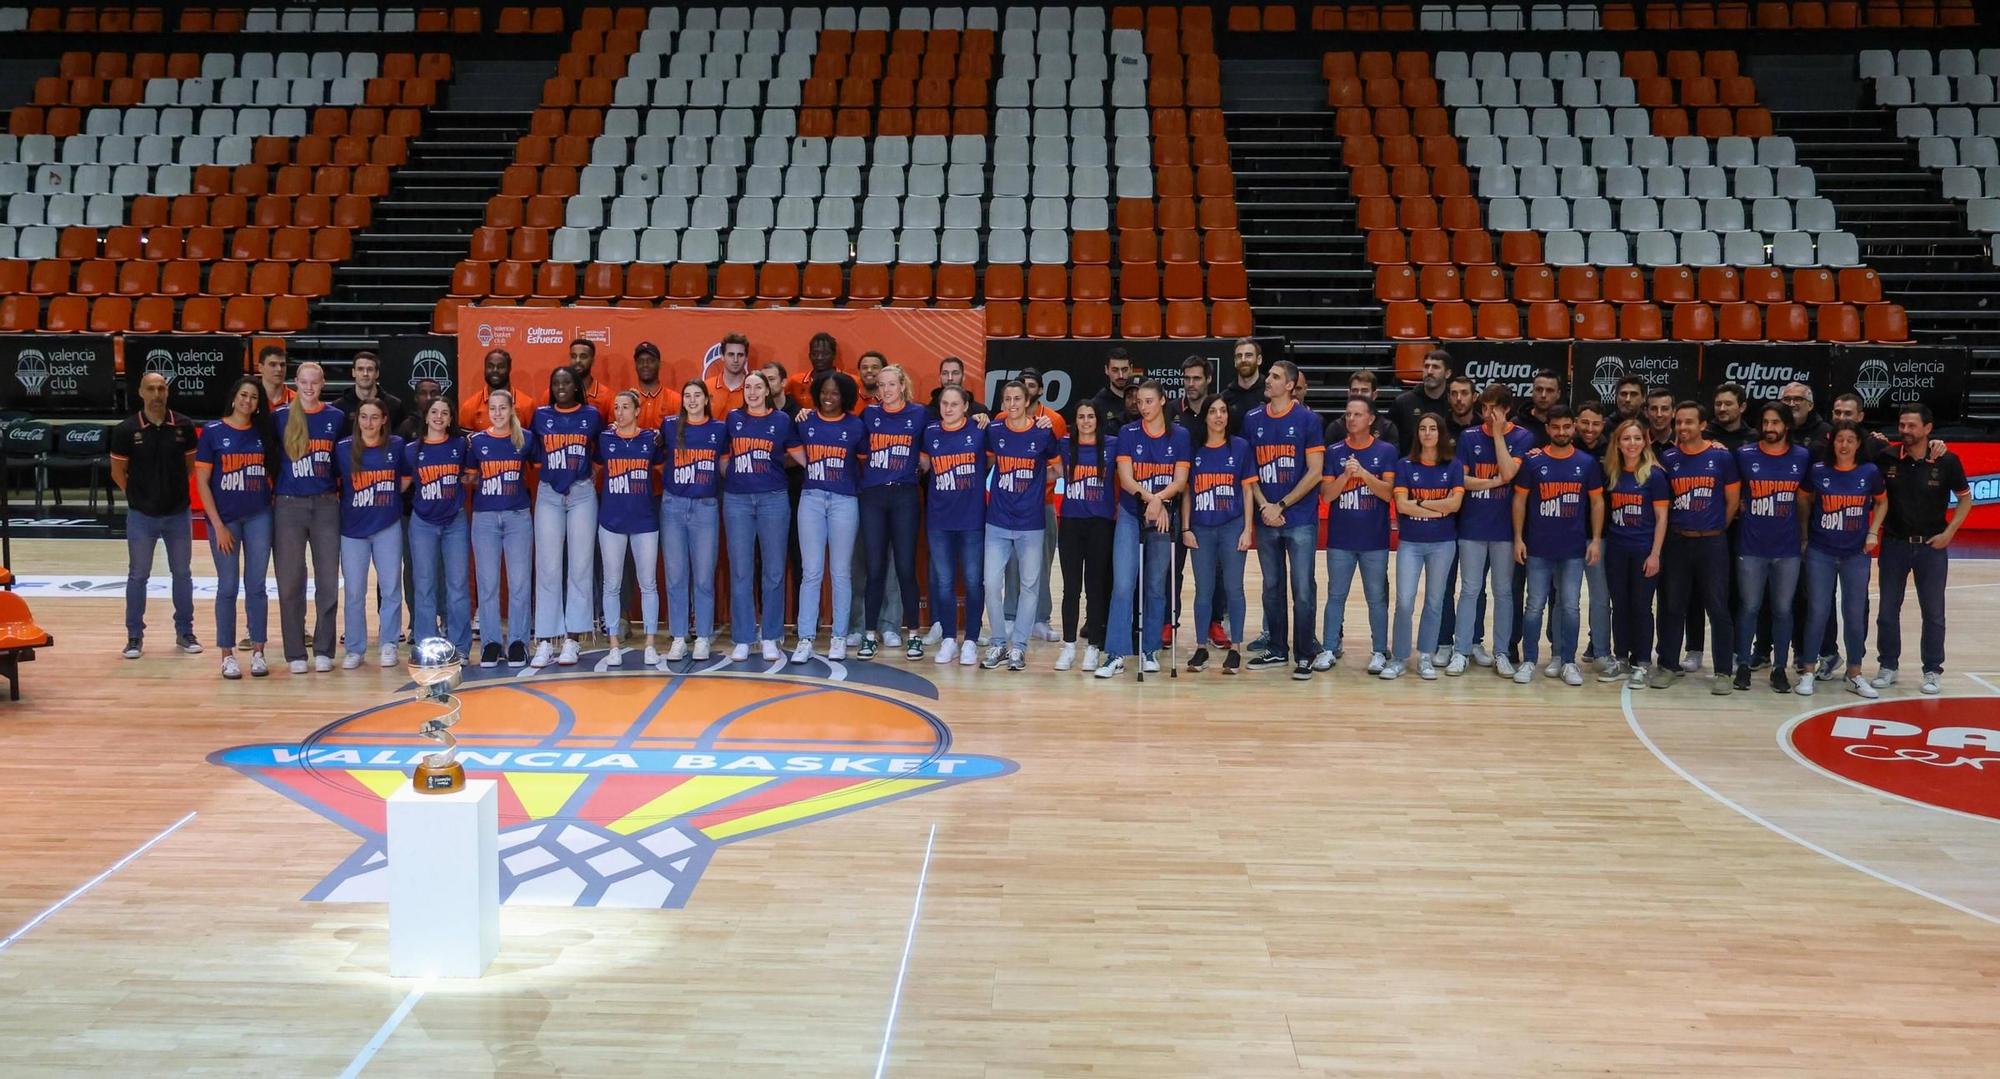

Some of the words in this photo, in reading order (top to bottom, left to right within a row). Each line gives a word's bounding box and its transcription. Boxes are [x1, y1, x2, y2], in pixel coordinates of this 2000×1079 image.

[527, 327, 555, 336] Cultura
[527, 335, 564, 344] Esfuerzo
[48, 348, 96, 361] valencia
[176, 348, 223, 362] valencia
[1629, 356, 1679, 370] valencia
[49, 362, 89, 376] basket
[177, 363, 216, 376] basket
[1465, 360, 1531, 379] Cultura
[1725, 362, 1793, 381] Cultura
[1794, 371, 1809, 381] del
[1893, 360, 1944, 373] valencia
[50, 376, 77, 389] club
[177, 377, 204, 390] club
[1893, 374, 1935, 388] basket
[1891, 388, 1920, 402] club
[543, 434, 588, 453] CAMPIONES
[568, 445, 586, 457] REINA
[732, 437, 774, 456] CAMPIONES
[870, 433, 913, 451] CAMPIONES
[891, 445, 910, 457] REINA
[674, 448, 715, 468] CAMPIONES
[806, 444, 847, 463] CAMPIONES
[870, 449, 889, 469] COPA
[1256, 444, 1296, 466] CAMPIONES
[1278, 457, 1295, 468] REINA
[246, 465, 266, 477] REINA
[292, 456, 315, 478] COPA
[480, 460, 521, 479] CAMPIONES
[607, 459, 649, 477] CAMPIONES
[697, 460, 715, 472] REINA
[826, 458, 844, 468] REINA
[931, 452, 976, 475] CAMPIONES
[956, 464, 976, 476] REINA
[997, 455, 1036, 474] CAMPIONES
[1133, 462, 1174, 480] CAMPIONES
[221, 470, 245, 491] COPA
[352, 470, 395, 491] CAMPIONES
[418, 464, 460, 485] CAMPIONES
[504, 471, 520, 481] REINA
[630, 469, 648, 480] REINA
[674, 464, 695, 484] COPA
[935, 470, 956, 491] COPA
[998, 472, 1014, 492] COPA
[1016, 469, 1033, 479] REINA
[376, 481, 395, 491] REINA
[421, 480, 442, 500] COPA
[482, 475, 502, 495] COPA
[609, 474, 630, 494] COPA
[1066, 480, 1085, 500] COPA
[1194, 473, 1234, 494] CAMPIONES
[1215, 485, 1235, 497] REINA
[1539, 482, 1582, 501] CAMPIONES
[1671, 476, 1715, 496] CAMPIONES
[1694, 487, 1712, 498] REINA
[1749, 480, 1799, 499] CAMPIONES
[352, 487, 374, 507] COPA
[1195, 490, 1215, 511] COPA
[1339, 490, 1359, 510] COPA
[1562, 493, 1579, 503] REINA
[1673, 492, 1691, 510] COPA
[1776, 491, 1795, 502] REINA
[1822, 495, 1866, 512] CAMPIONES
[1540, 498, 1561, 517] COPA
[1625, 505, 1642, 515] REINA
[1751, 496, 1774, 516] COPA
[1846, 507, 1863, 516] REINA
[1821, 511, 1843, 530] COPA
[672, 754, 968, 774] BASKET
